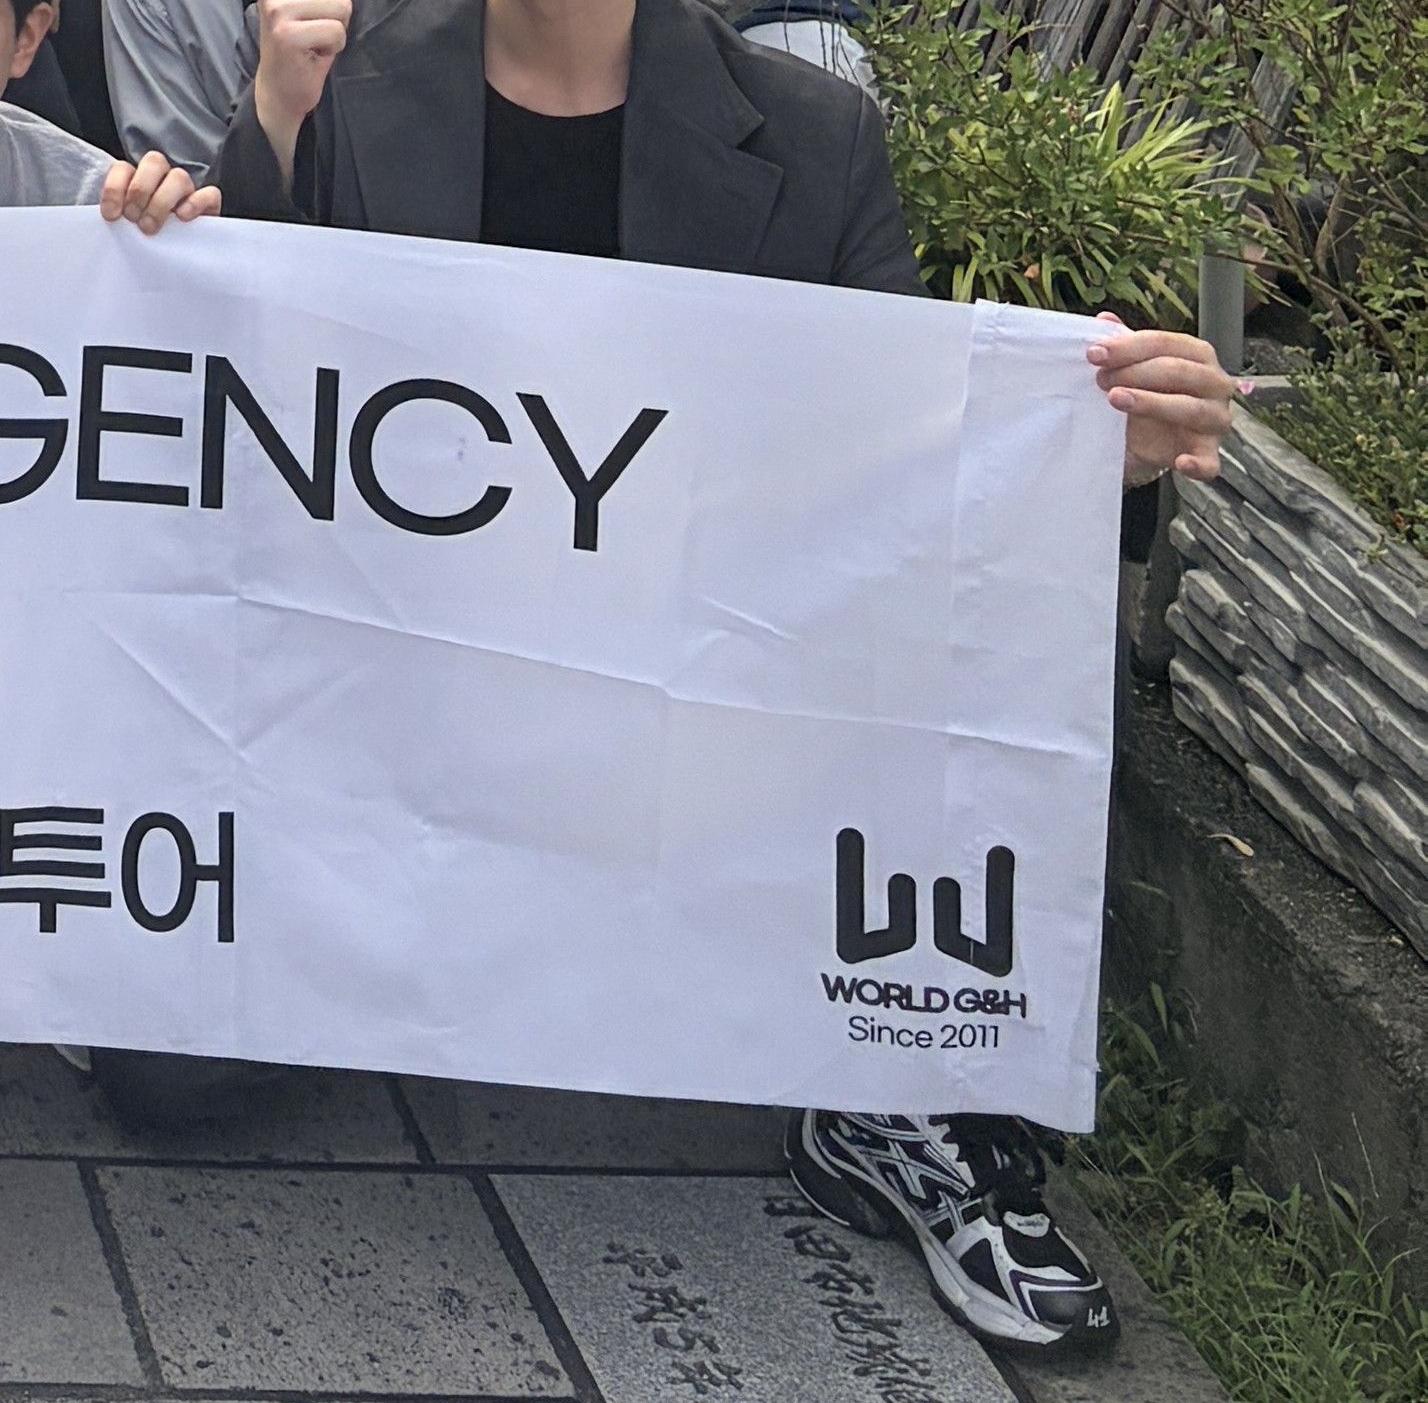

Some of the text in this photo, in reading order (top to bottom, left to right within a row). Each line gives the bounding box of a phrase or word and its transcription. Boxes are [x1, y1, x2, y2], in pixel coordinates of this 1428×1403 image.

[820, 972, 951, 1014] WORLD
[848, 1015, 999, 1050] Since 2011
